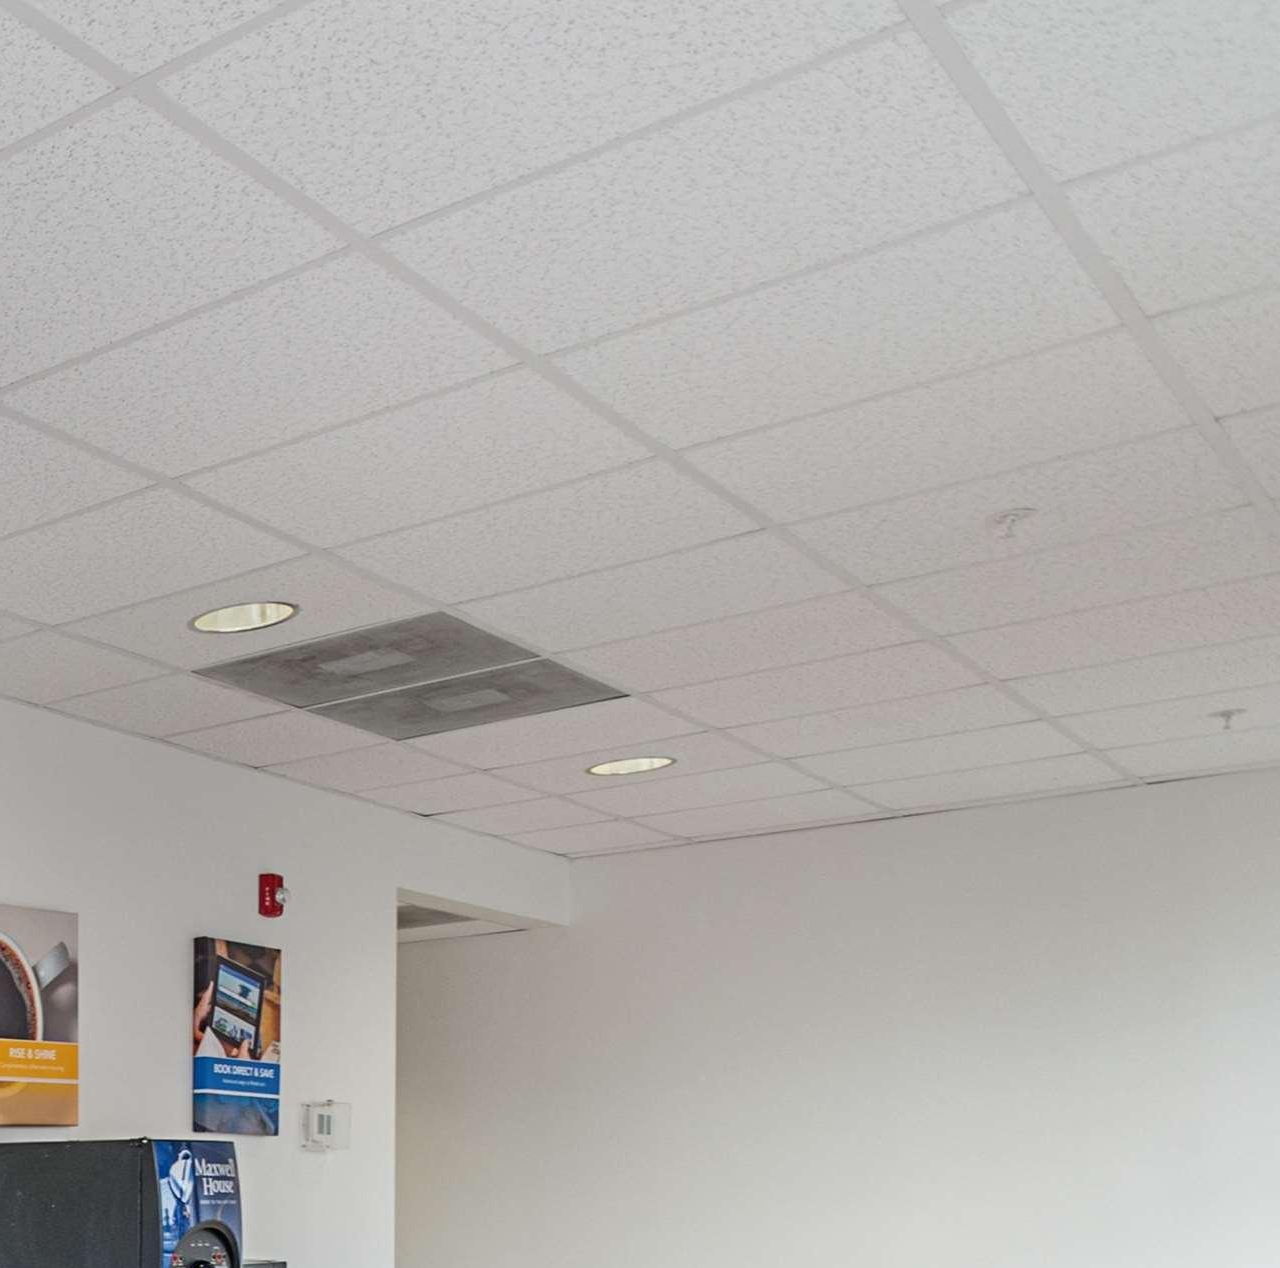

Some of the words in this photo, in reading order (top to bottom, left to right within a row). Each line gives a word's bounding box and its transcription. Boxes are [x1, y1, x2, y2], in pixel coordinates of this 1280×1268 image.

[8, 1047, 26, 1058] RISE
[26, 1048, 34, 1060] &
[34, 1049, 57, 1060] SHINE
[214, 1063, 232, 1074] BOOK
[232, 1065, 253, 1076] DIRECT
[259, 1068, 274, 1078] SAVE
[194, 1158, 236, 1177] Maxwell
[202, 1177, 234, 1196] House
